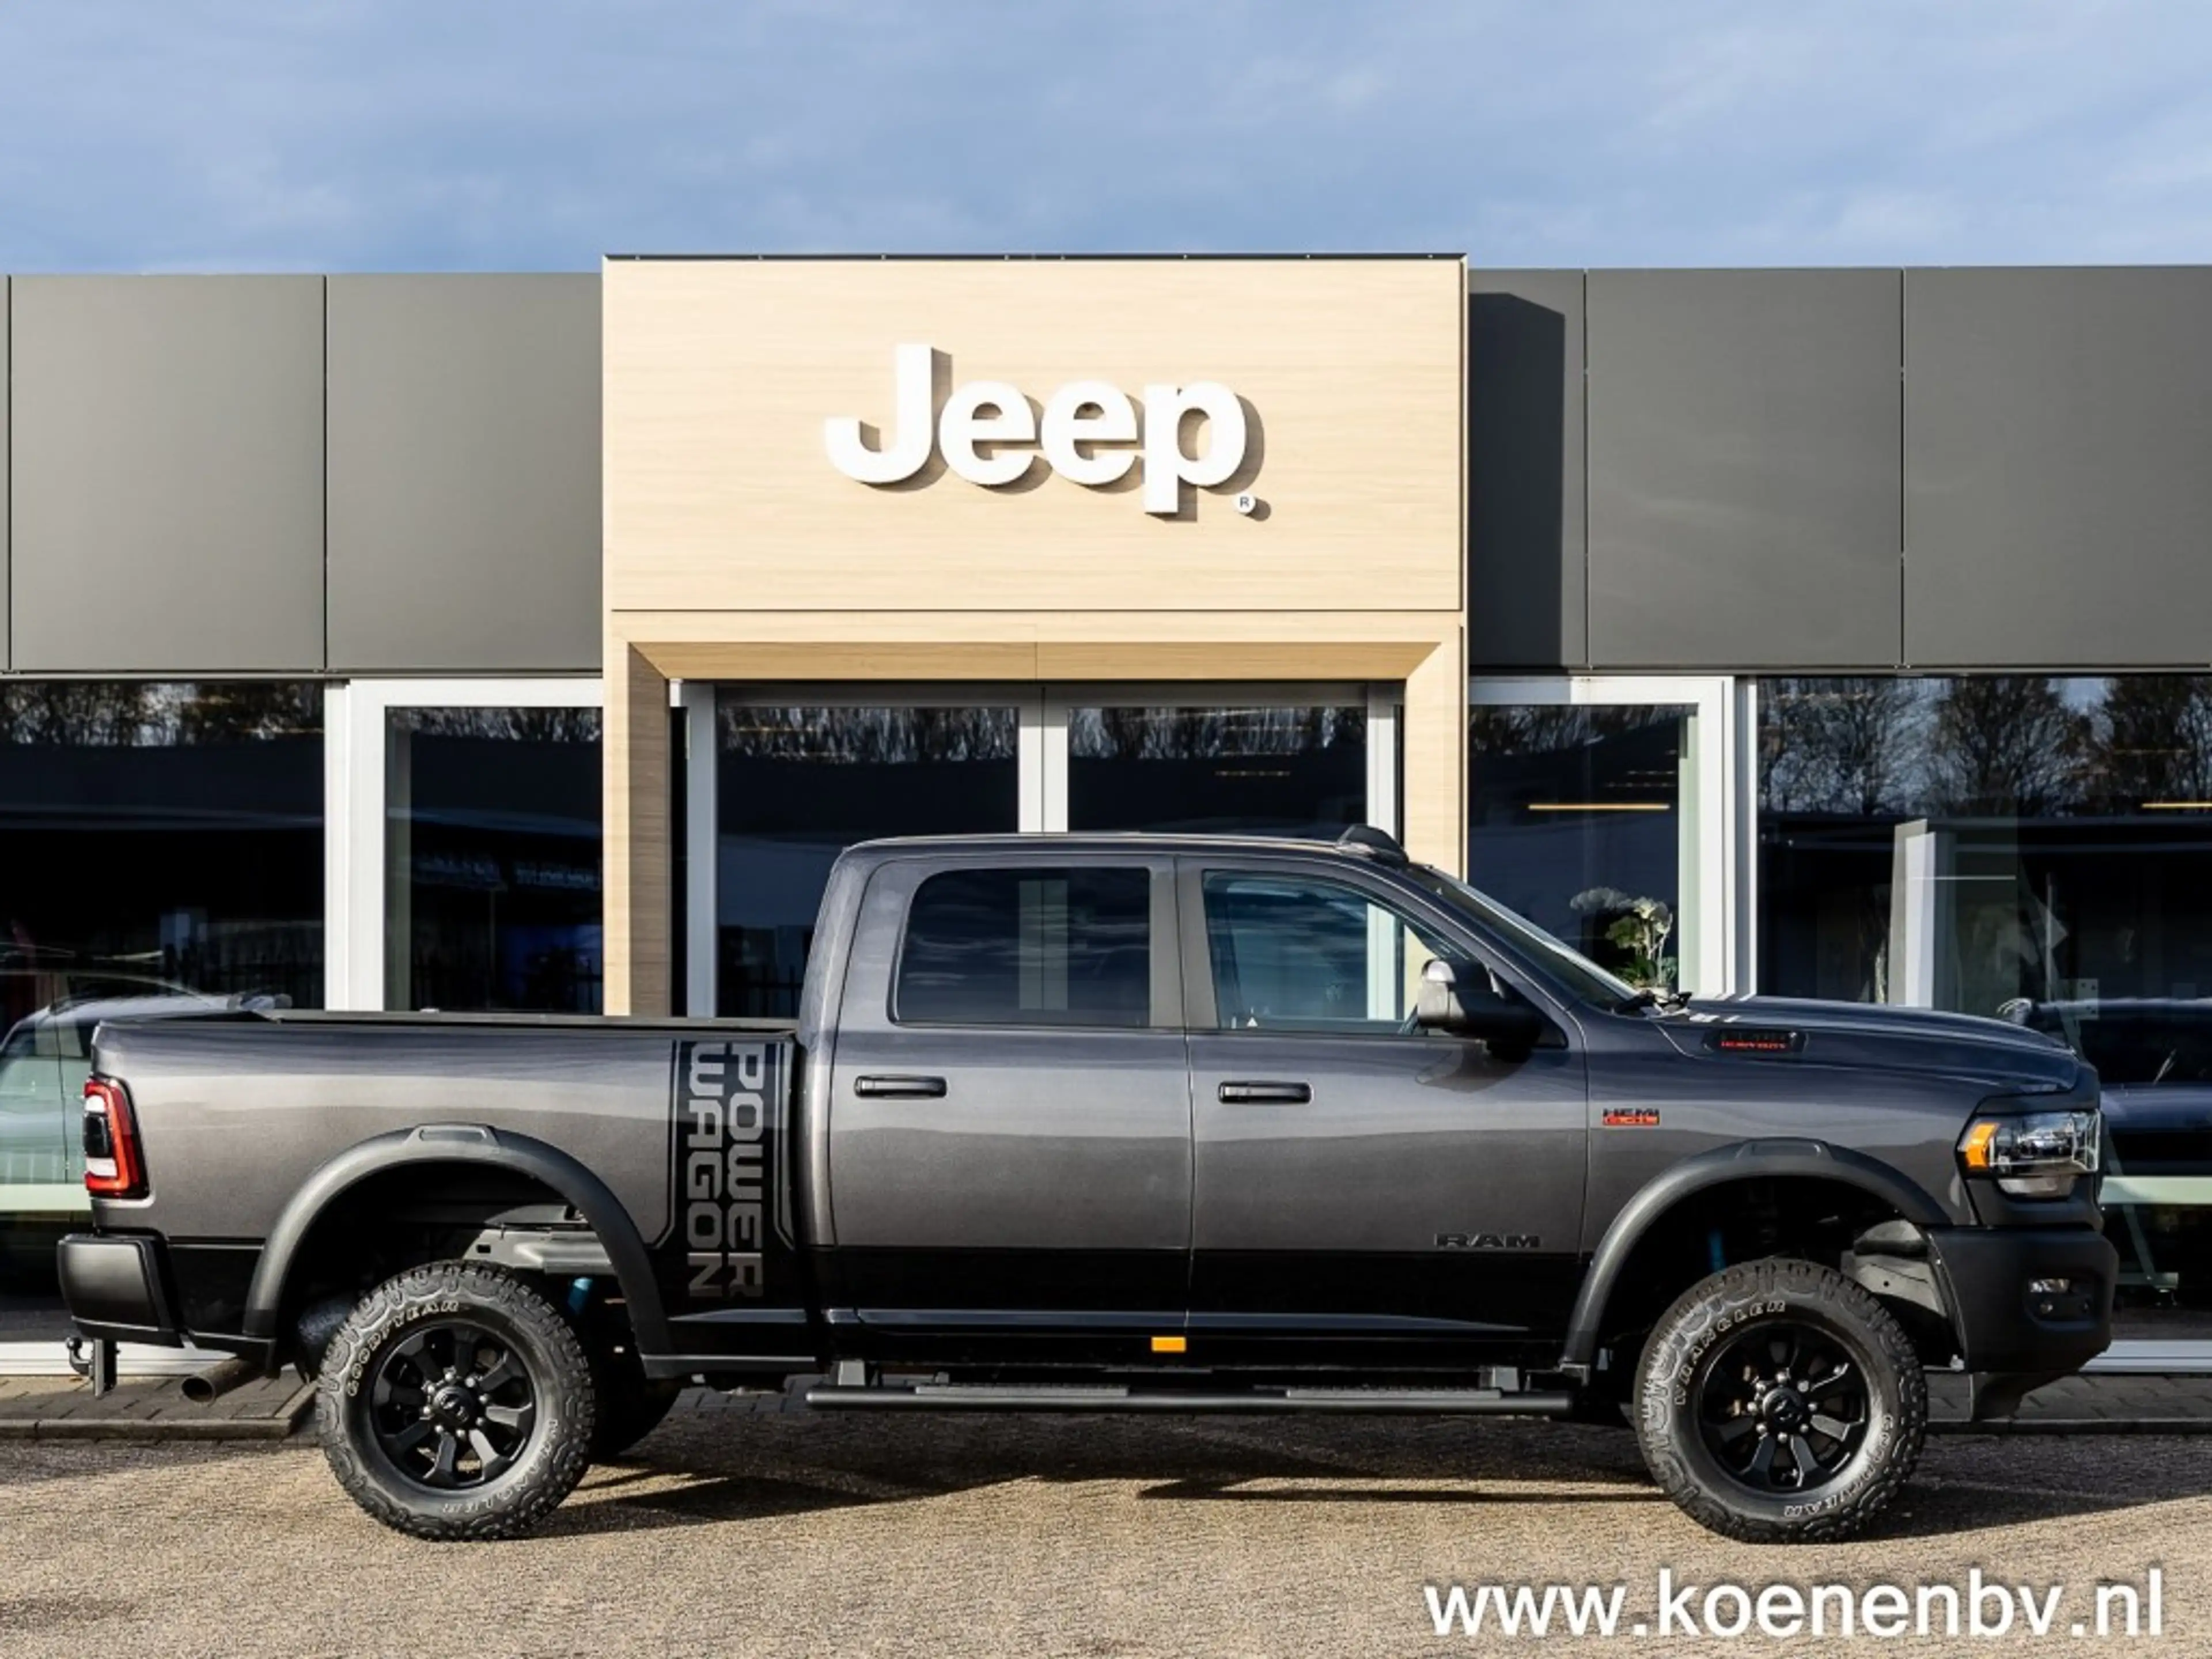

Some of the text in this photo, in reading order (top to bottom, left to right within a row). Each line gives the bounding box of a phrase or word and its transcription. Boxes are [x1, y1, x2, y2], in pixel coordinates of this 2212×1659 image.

[824, 343, 1247, 513] Jeep
[687, 1043, 726, 1297] WAGON
[728, 1043, 766, 1297] POWER
[1434, 1233, 1541, 1248] RAM
[347, 1300, 459, 1396] GOODYEAR
[1675, 1300, 1786, 1405] WRANGLER
